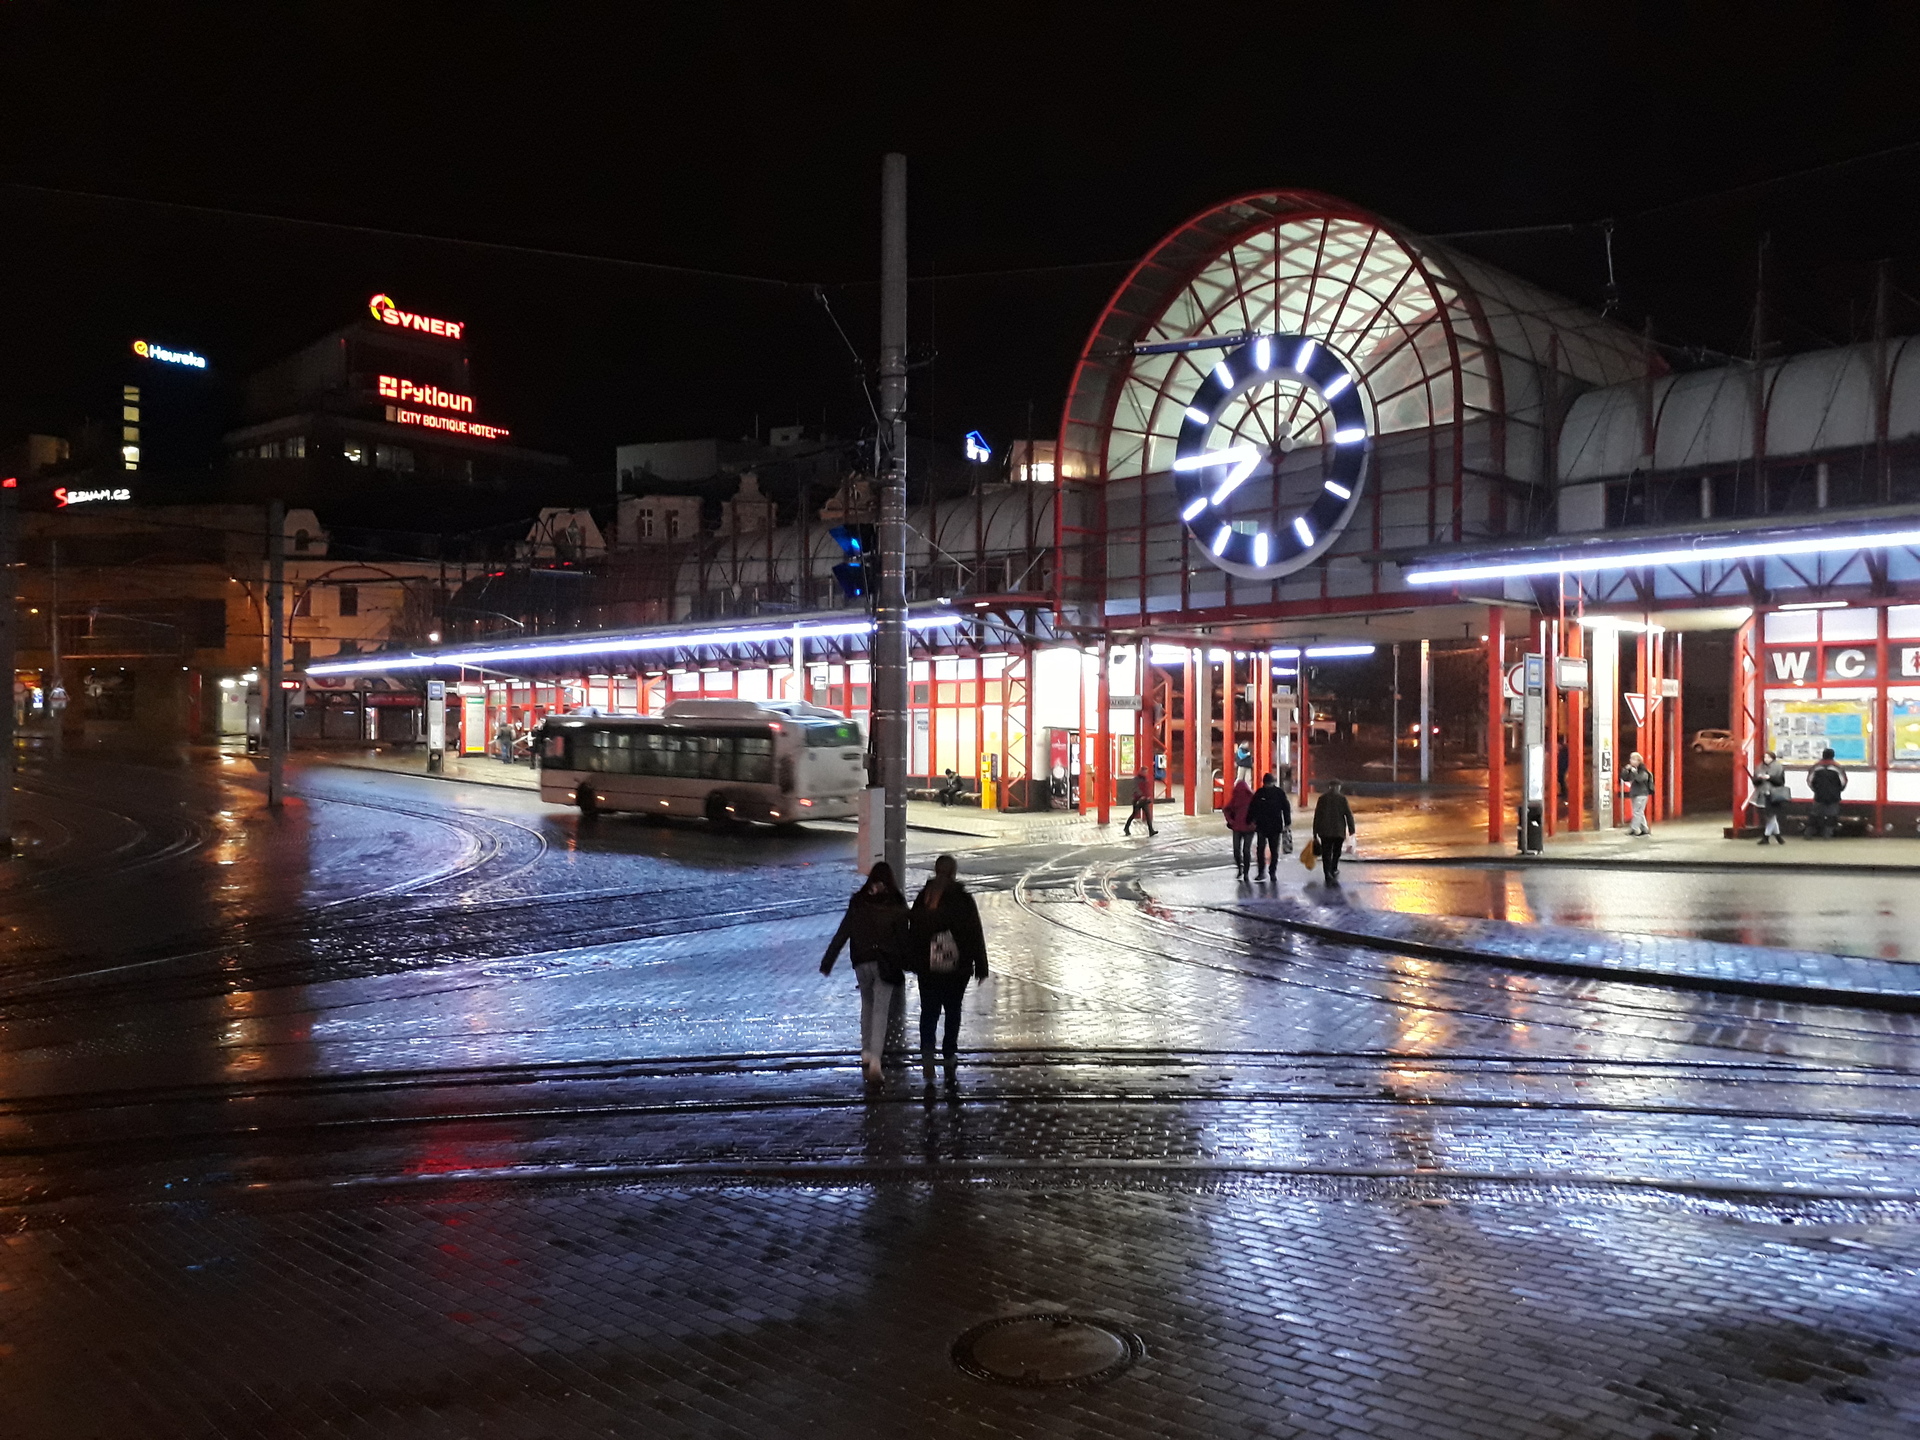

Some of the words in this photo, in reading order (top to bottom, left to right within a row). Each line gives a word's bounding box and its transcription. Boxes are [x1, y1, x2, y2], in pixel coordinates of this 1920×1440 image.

[383, 308, 461, 339] SYNER
[149, 344, 206, 368] Heureka
[401, 379, 472, 413] Pytloun
[401, 410, 421, 425] CITY
[423, 414, 467, 434] BOUTIQUE
